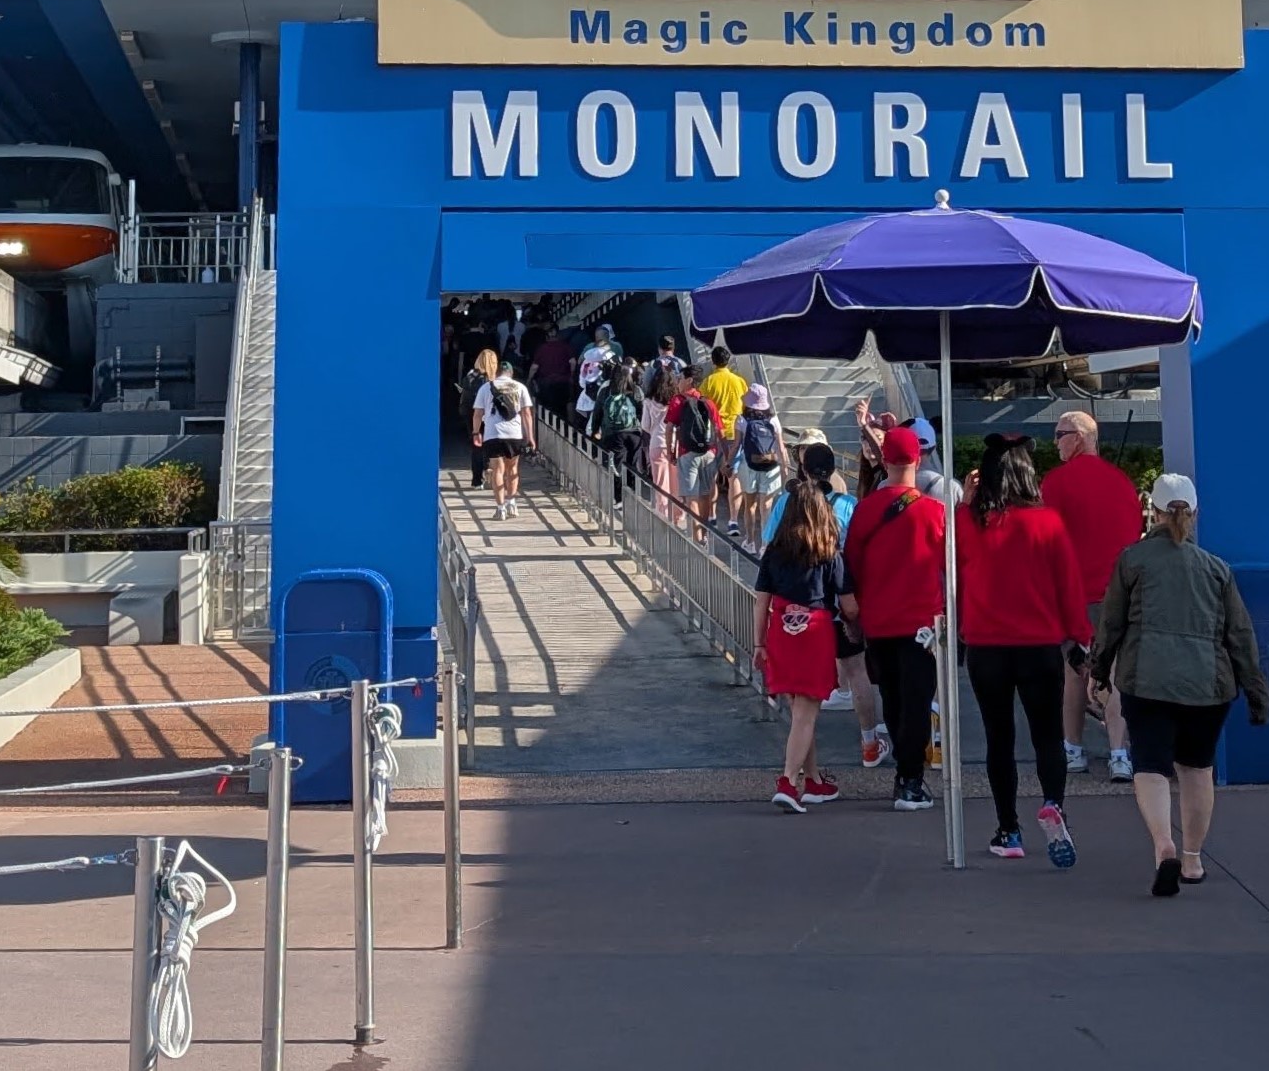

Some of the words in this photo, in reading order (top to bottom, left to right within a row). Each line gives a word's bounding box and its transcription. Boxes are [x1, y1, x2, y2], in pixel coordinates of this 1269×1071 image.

[569, 10, 749, 54] Magic
[783, 10, 1048, 55] Kingdom
[450, 89, 1175, 180] MONORAIL
